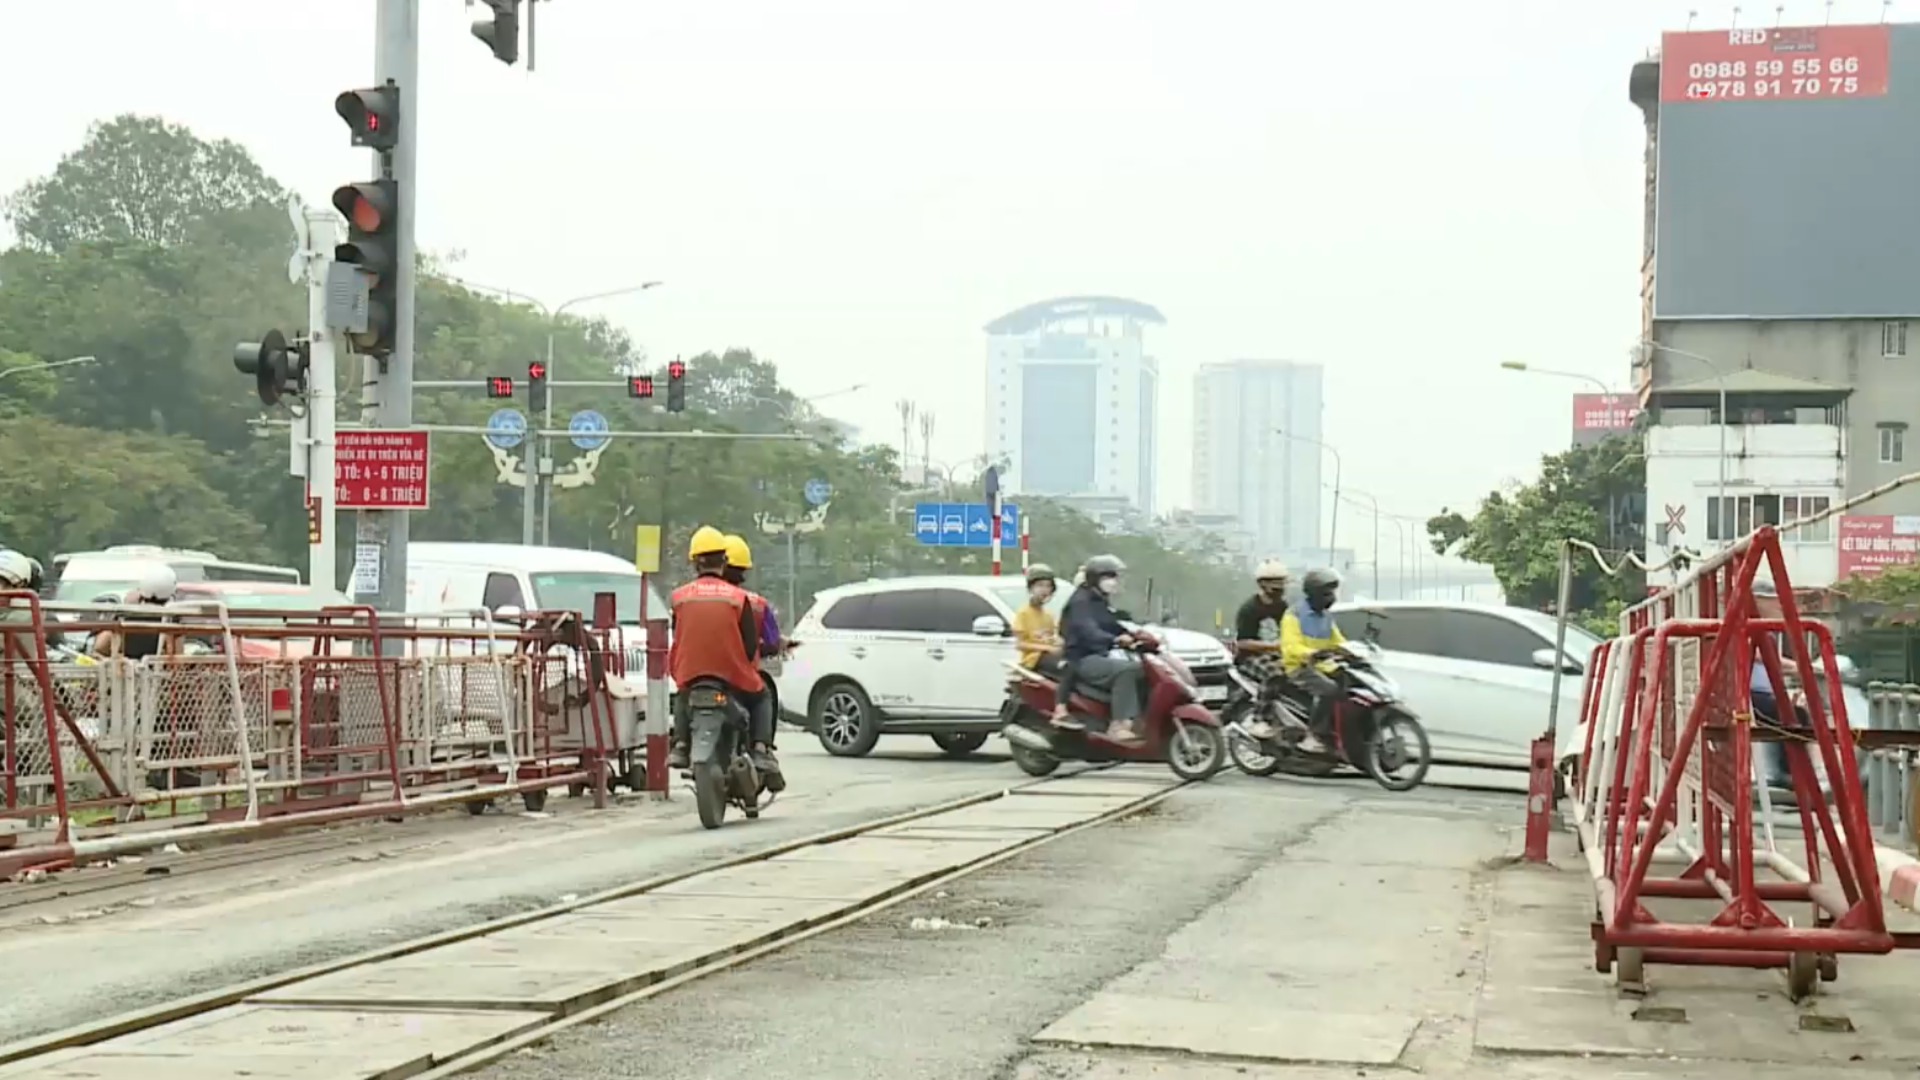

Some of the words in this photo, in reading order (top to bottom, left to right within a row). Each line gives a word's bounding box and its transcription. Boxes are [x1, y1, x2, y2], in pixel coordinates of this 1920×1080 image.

[1728, 28, 1767, 45] RED
[1689, 61, 1747, 79] 0988
[1755, 60, 1784, 77] 59
[1792, 58, 1821, 75] 55
[1829, 57, 1859, 74] 66
[1687, 79, 1746, 98] 0978
[1754, 79, 1781, 96] 91
[1792, 78, 1821, 95] 70
[1828, 77, 1858, 94] 75
[356, 449, 367, 461] XE
[344, 462, 361, 480] TÔ:
[363, 465, 371, 480] 4
[380, 465, 388, 480] 6
[391, 463, 424, 483] TRIỆU
[363, 486, 371, 502] 6
[380, 486, 388, 502] 8
[391, 484, 422, 504] TRIỆU
